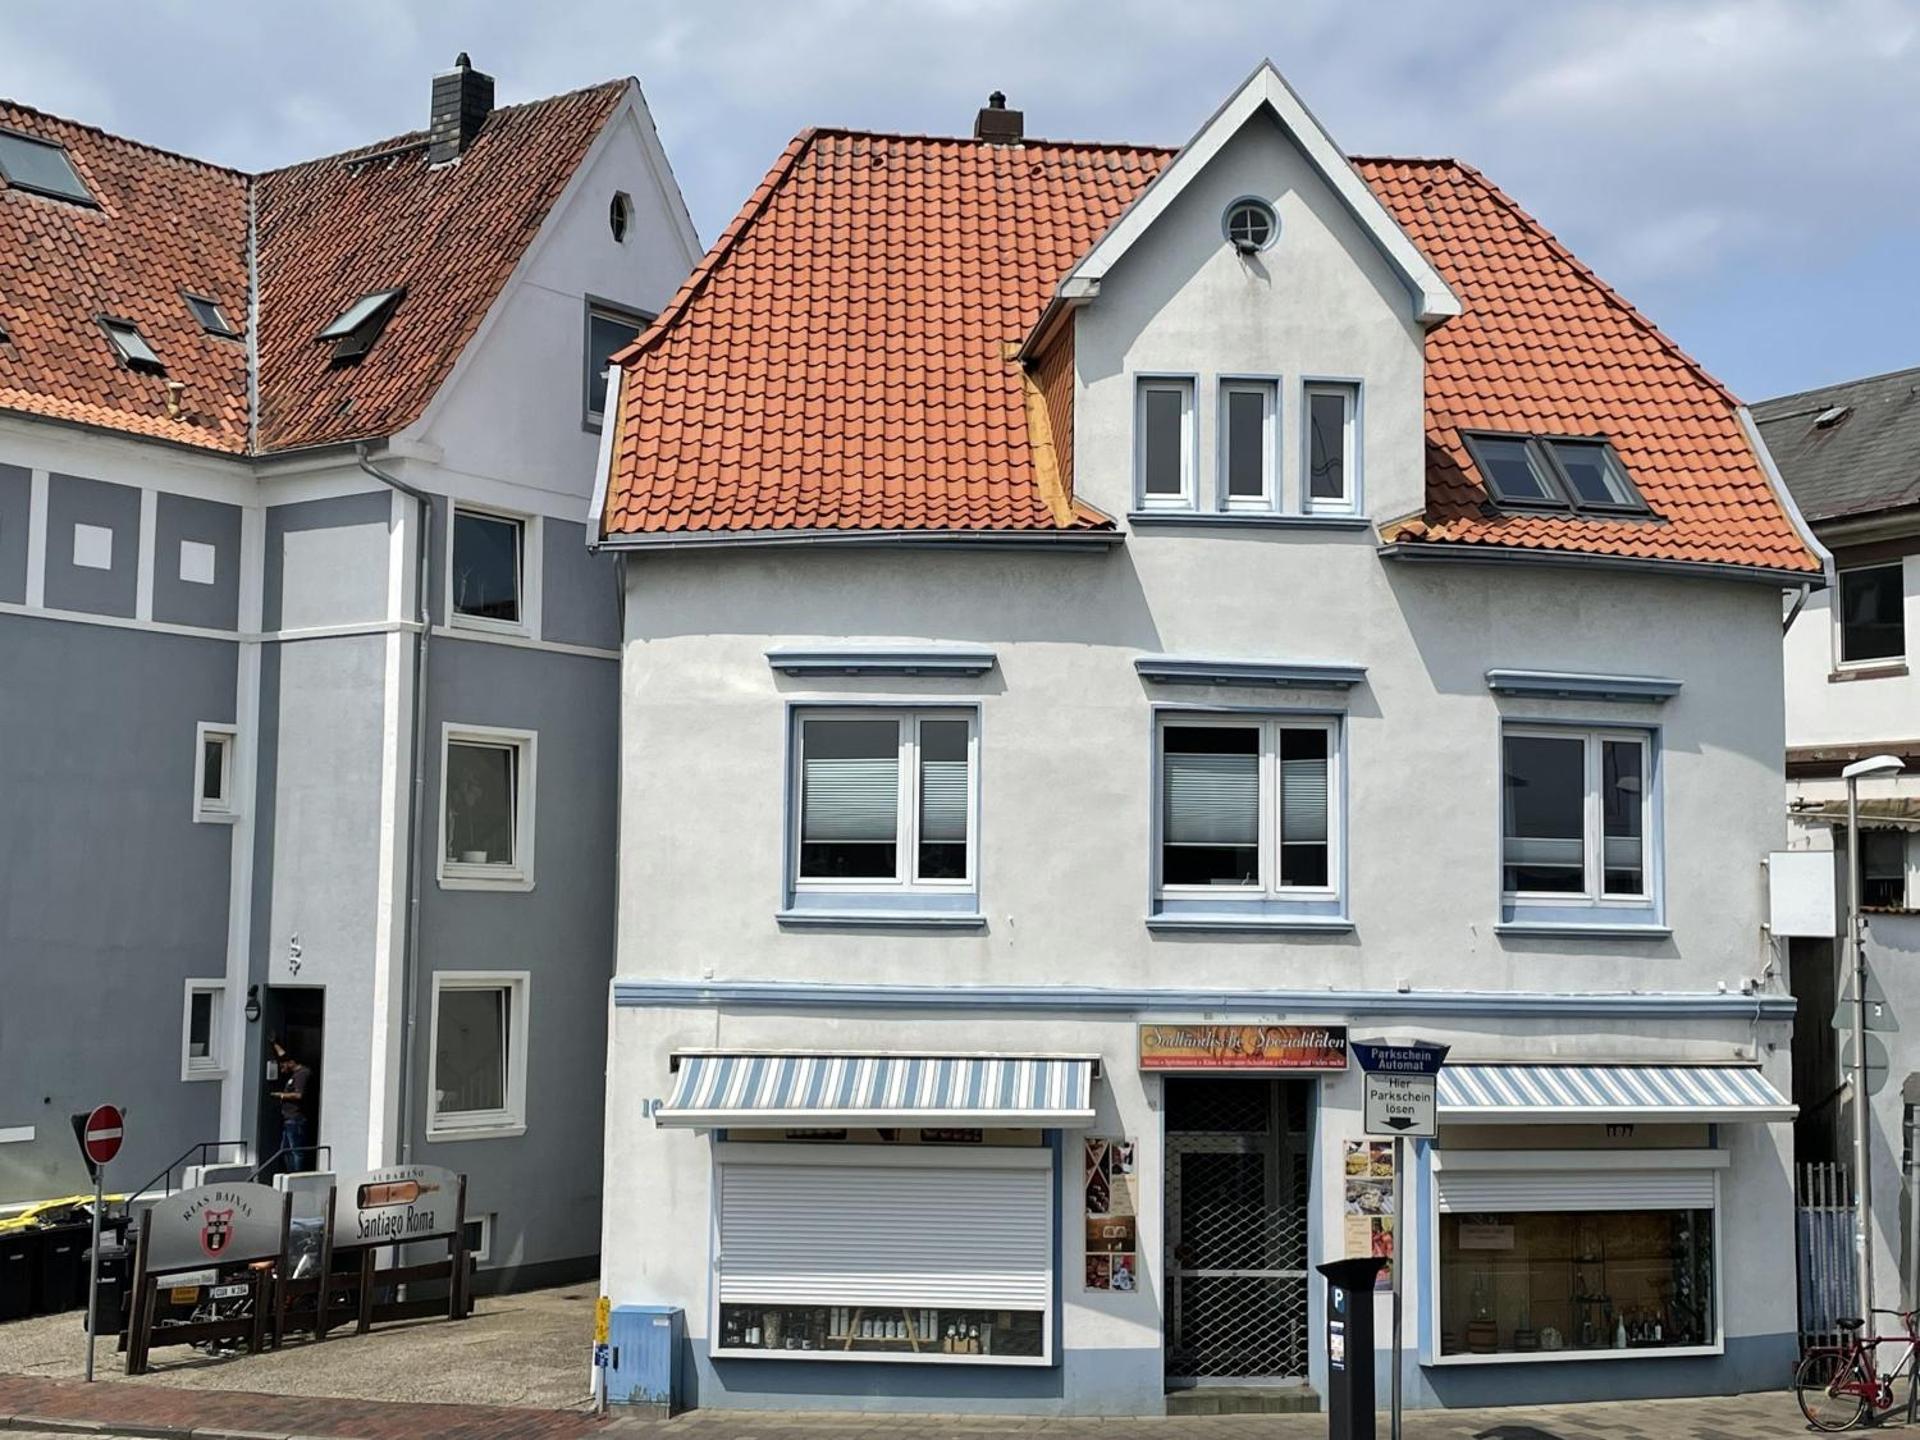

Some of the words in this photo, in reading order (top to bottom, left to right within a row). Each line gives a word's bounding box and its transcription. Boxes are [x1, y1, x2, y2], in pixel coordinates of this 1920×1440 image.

[1257, 1026, 1345, 1049] Spezialitäten
[1371, 1048, 1431, 1060] Parkschein
[1378, 1060, 1424, 1071] Automat
[1389, 1077, 1412, 1088] Hier
[1370, 1089, 1431, 1102] Parkschein
[1385, 1103, 1415, 1114] lösen
[357, 1210, 403, 1240] Santiago
[406, 1205, 435, 1233] Roma
